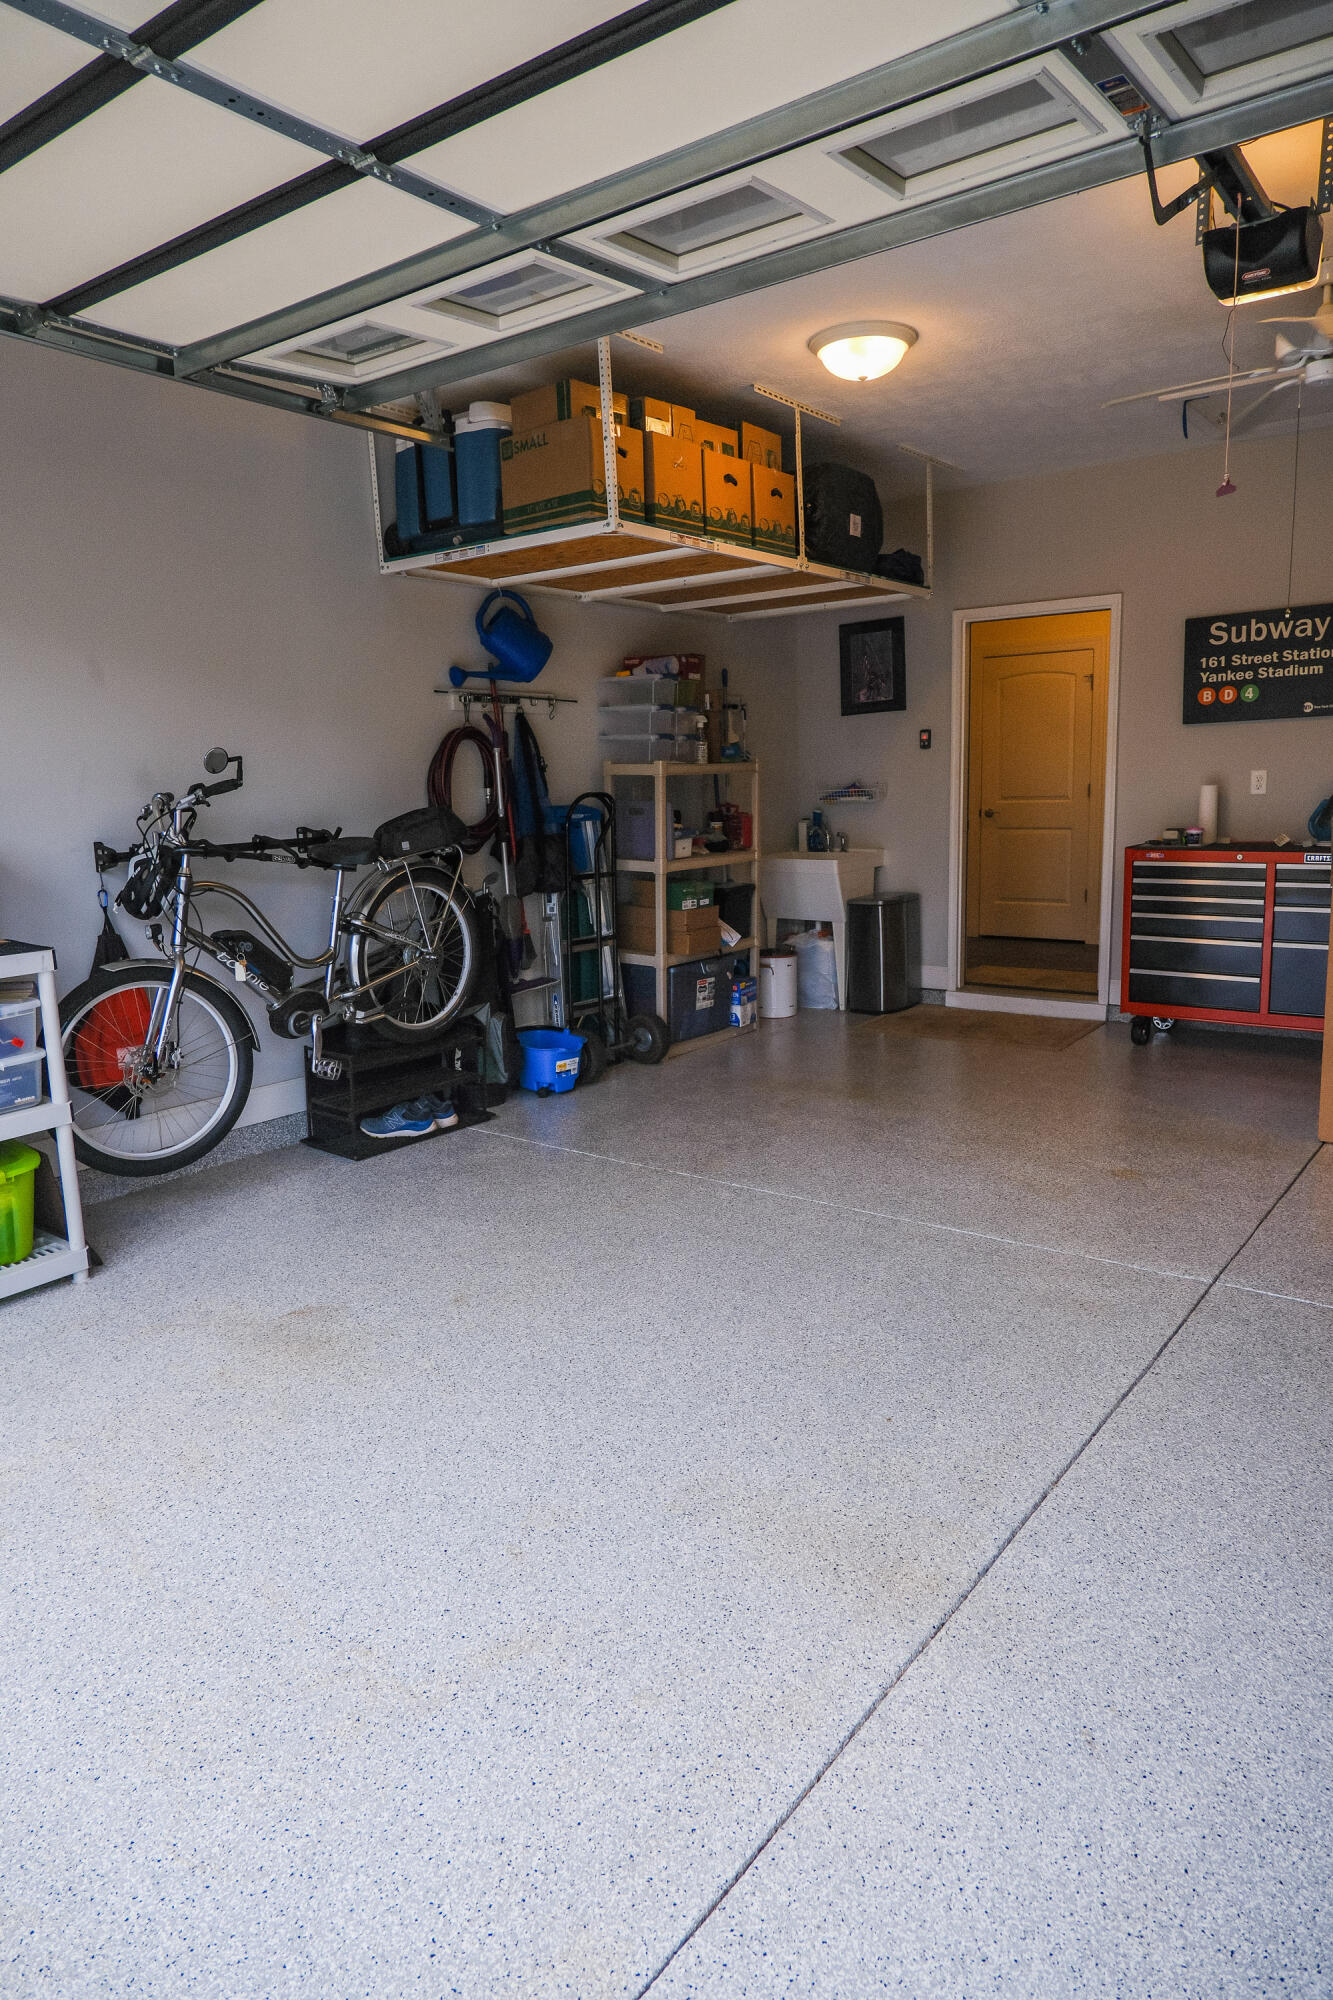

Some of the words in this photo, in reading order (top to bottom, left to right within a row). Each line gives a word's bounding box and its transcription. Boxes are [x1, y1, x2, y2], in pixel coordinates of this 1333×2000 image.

[514, 432, 549, 453] SMALL
[1209, 617, 1331, 645] Subway
[1200, 656, 1226, 669] 161
[1231, 652, 1279, 666] Street
[1282, 648, 1333, 661] Statio
[1200, 670, 1254, 683] Yankee
[1258, 665, 1324, 678] Stadium
[1203, 691, 1212, 702] B
[1224, 689, 1233, 700] D
[1245, 687, 1254, 699] 4
[216, 951, 269, 991] tonie
